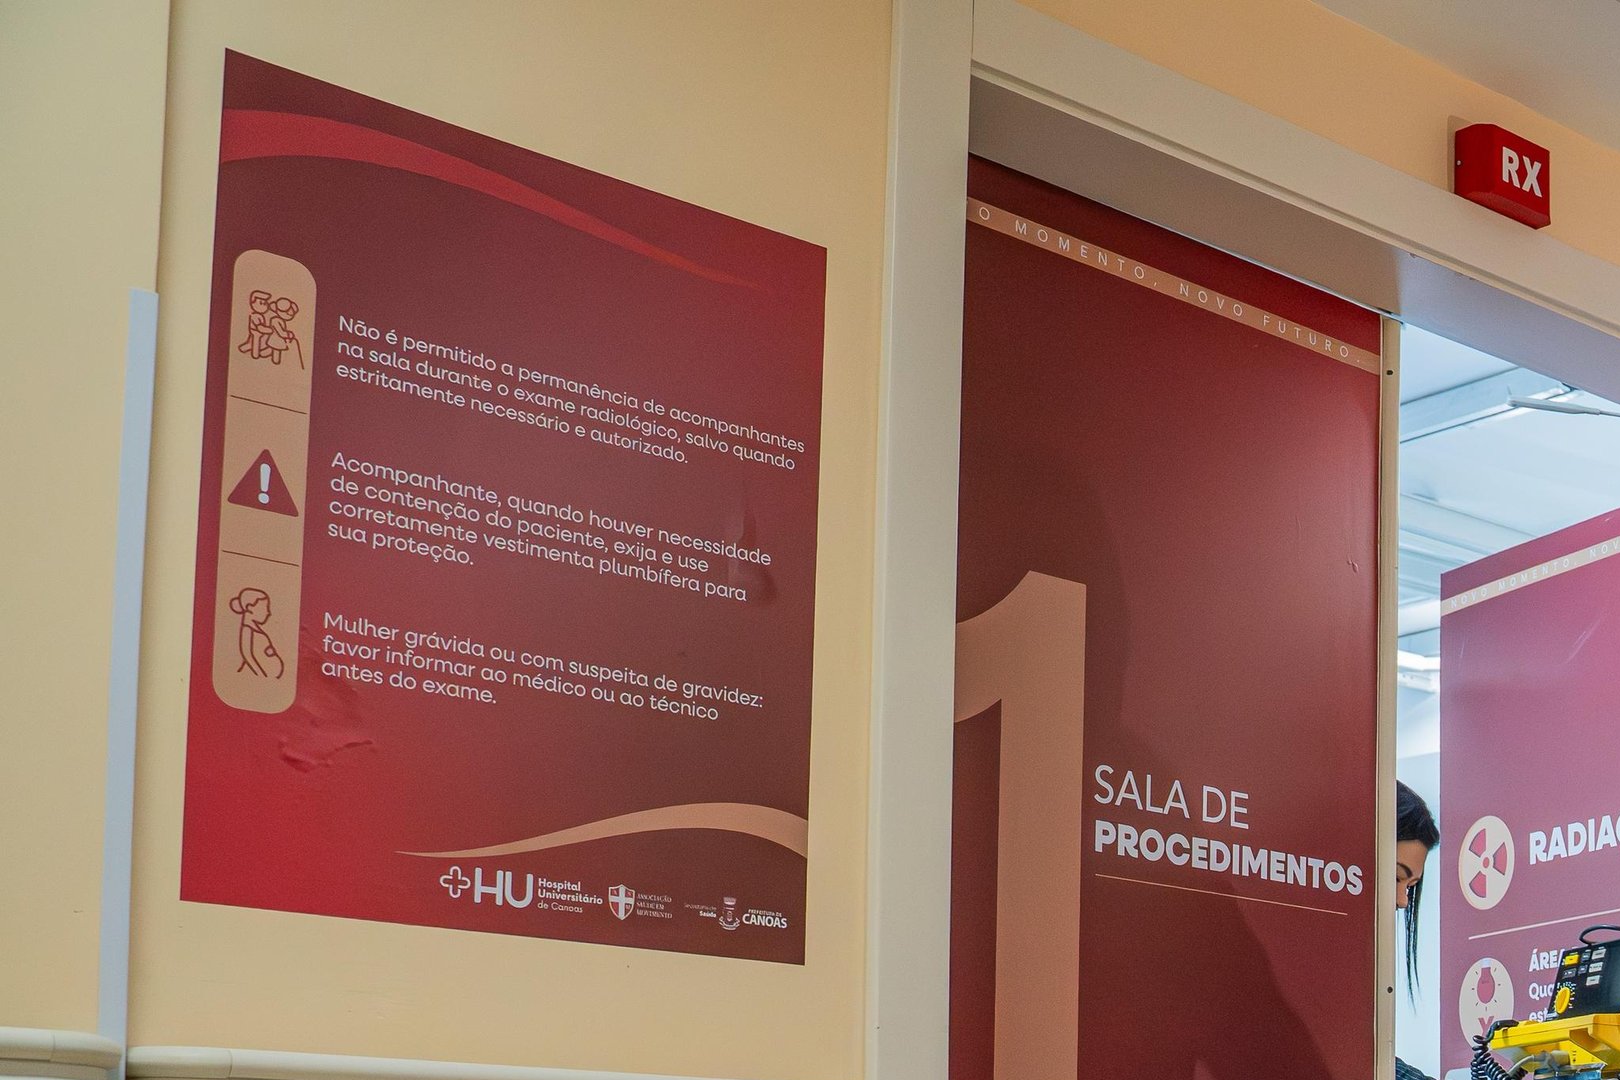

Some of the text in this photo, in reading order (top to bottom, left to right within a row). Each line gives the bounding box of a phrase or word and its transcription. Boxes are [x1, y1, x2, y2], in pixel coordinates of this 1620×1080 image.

[1502, 146, 1542, 198] RX
[1015, 219, 1158, 287] MOMENTO,
[1179, 282, 1244, 317] NOVO
[1263, 315, 1361, 363] FUTURO.
[336, 364, 689, 464] estritamente necessário e autorizado.
[338, 314, 805, 453] Não é permitido a permanência de acompanhantes
[338, 341, 796, 470] na sala durante o exame radiológico, salvo quando
[328, 522, 475, 566] sua proteção.
[330, 475, 709, 573] de contenção do paciente, exija e use
[331, 452, 772, 567] Acompanhante, quando houver necessidade
[329, 500, 748, 602] corretamente vestimenta plumbífera para
[321, 661, 498, 704] antes do exame.
[322, 635, 719, 721] favor informar ao médico ou ao técnico
[323, 612, 764, 709] Mulher grávida ou com suspeita de gravidez:
[1094, 764, 1249, 829] SALA DE
[473, 867, 534, 909] HU
[538, 878, 582, 892] Hospital
[1094, 819, 1363, 896] PROCEDIMENTOS
[537, 901, 583, 913] de Canoas
[538, 888, 603, 905] Universitário
[742, 913, 788, 929] CANOAS
